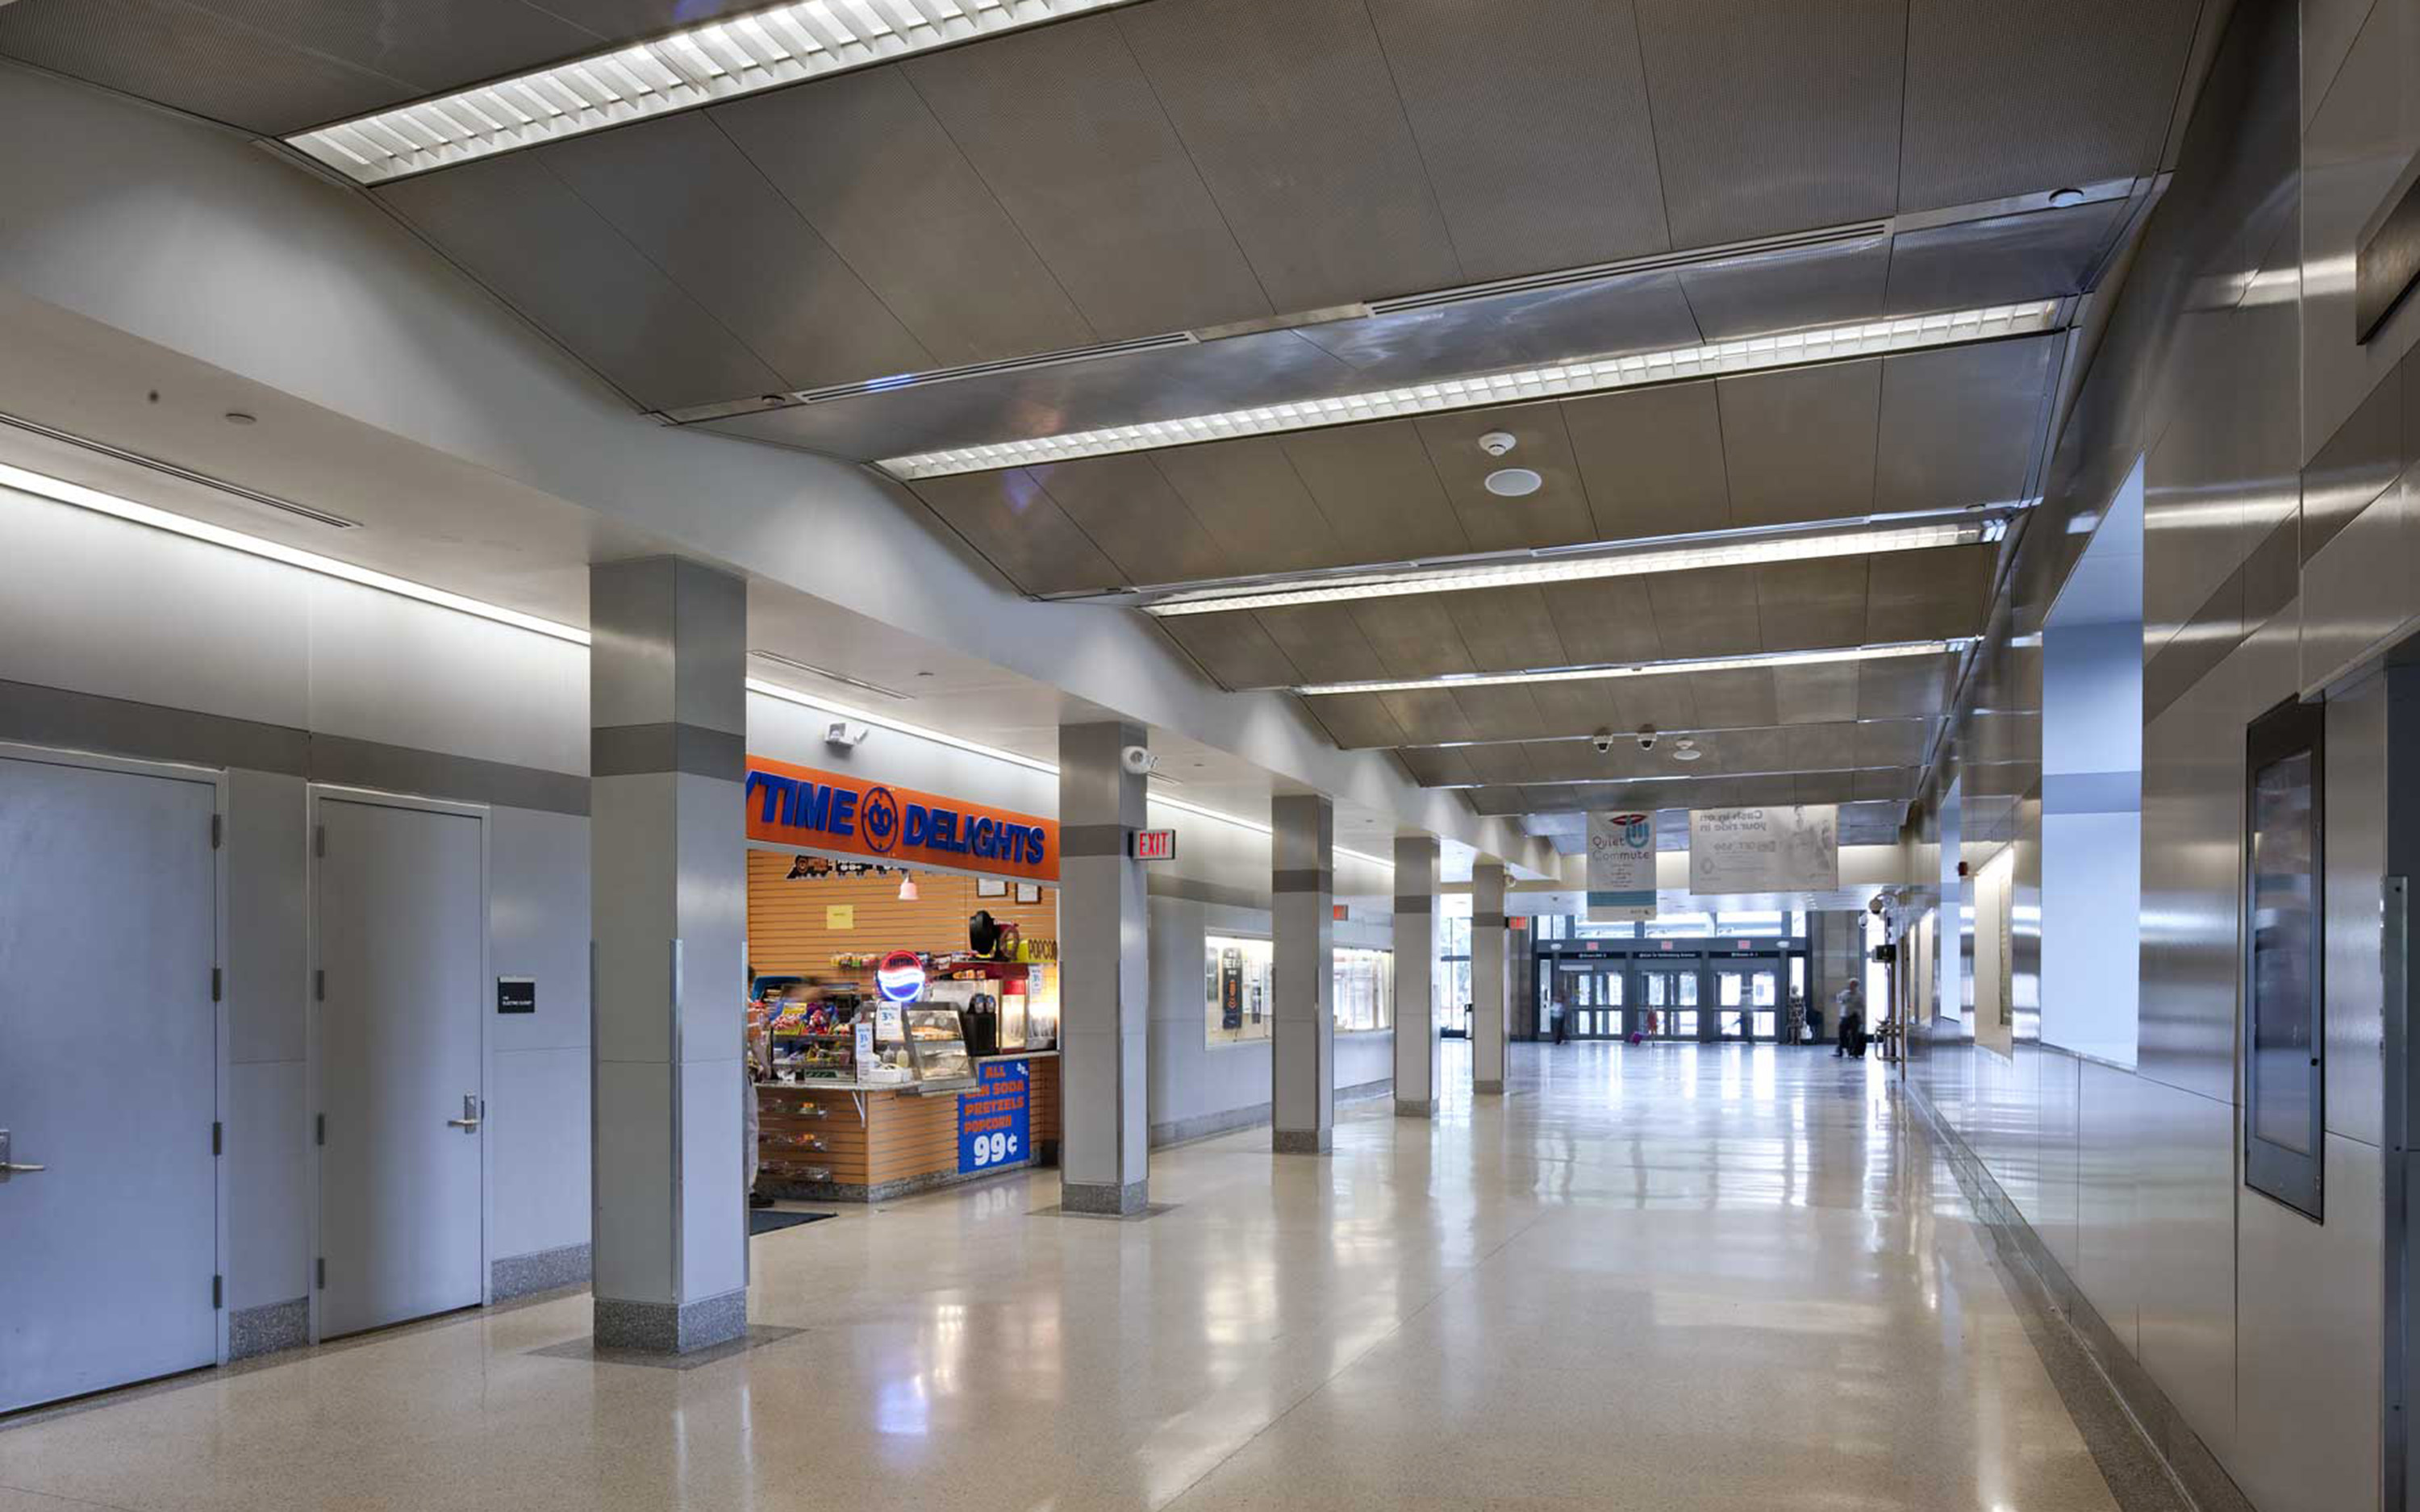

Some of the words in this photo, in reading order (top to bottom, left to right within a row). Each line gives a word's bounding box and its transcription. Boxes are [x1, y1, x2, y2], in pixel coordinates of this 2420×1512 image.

[903, 804, 1045, 865] DELIGHTS
[1139, 832, 1169, 856] EXIT
[1592, 835, 1625, 850] Quiet
[1592, 849, 1650, 861] Commute
[986, 1066, 1006, 1078] ALL
[993, 1081, 1024, 1094] SODA
[965, 1095, 1024, 1116] PRETZELS
[965, 1115, 1012, 1135] POPCORN
[974, 1132, 1018, 1166] 99¢
